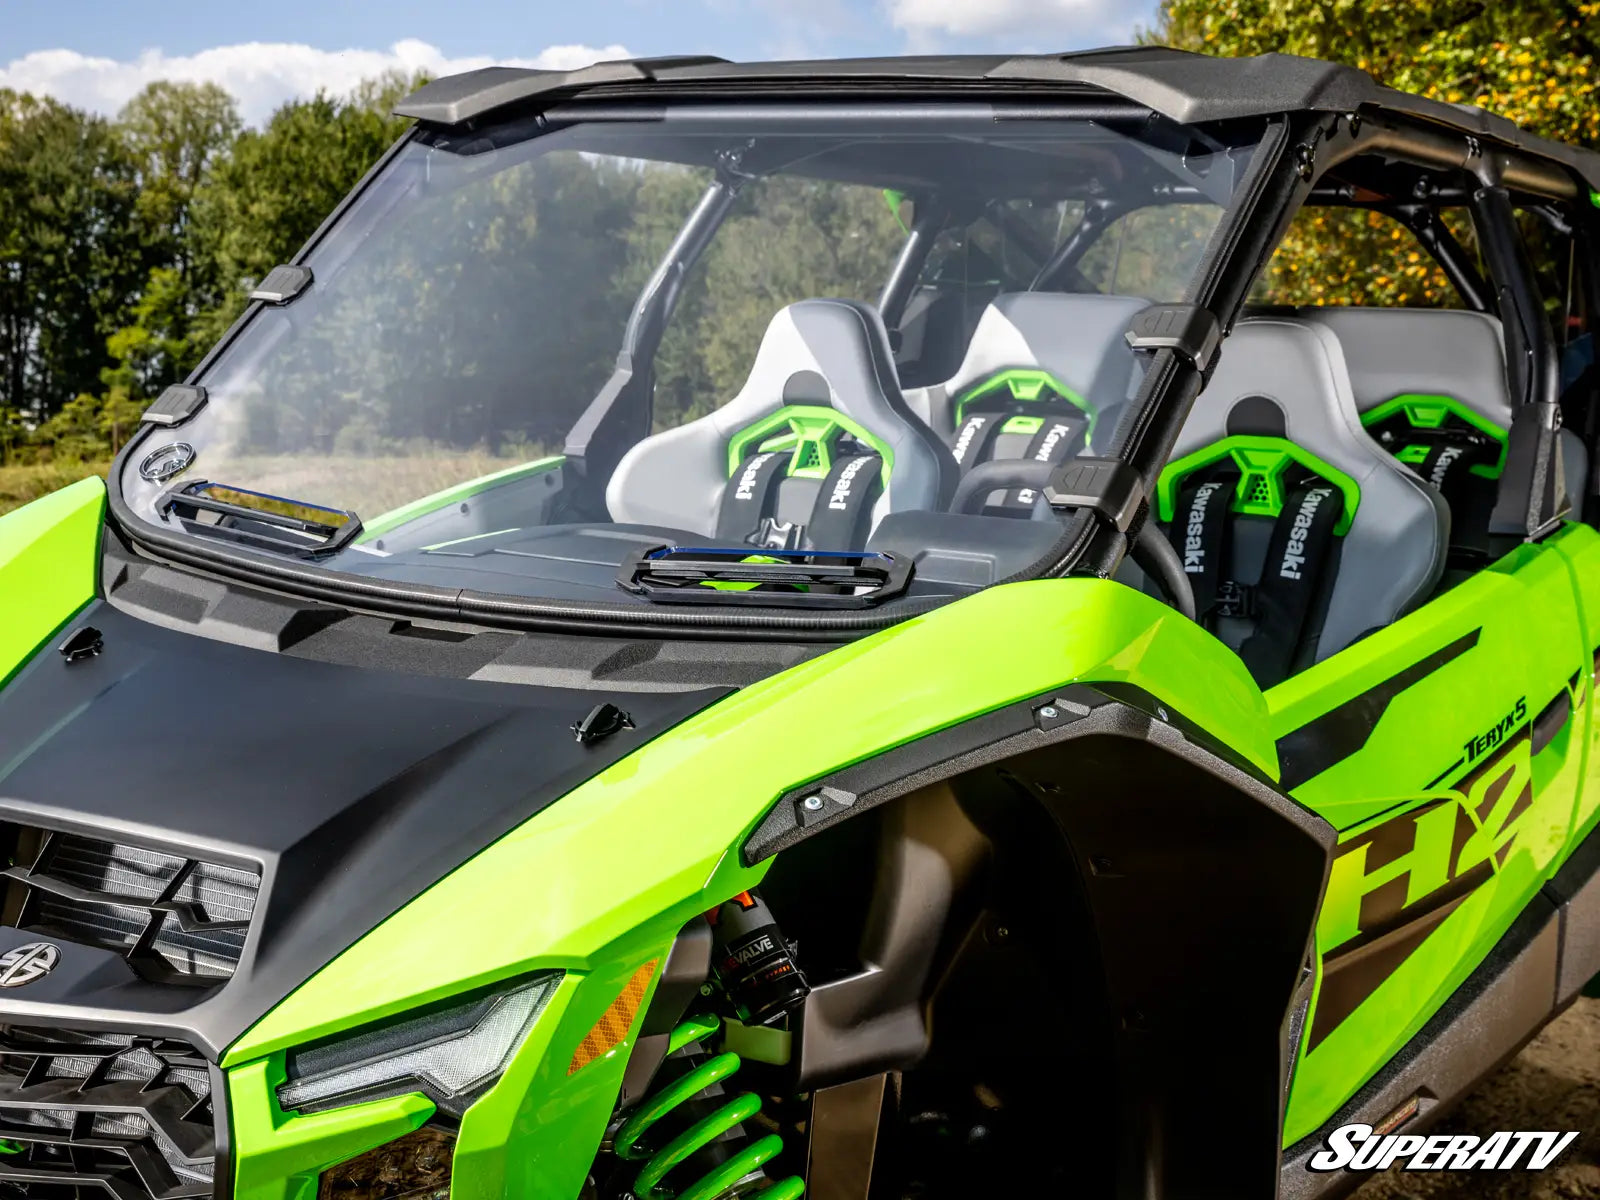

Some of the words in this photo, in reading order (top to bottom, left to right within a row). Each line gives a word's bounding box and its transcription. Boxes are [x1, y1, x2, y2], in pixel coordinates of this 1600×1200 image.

[1184, 482, 1223, 573] Kawasaki
[1279, 488, 1333, 580] Kawasaki
[1315, 737, 1534, 956] H2
